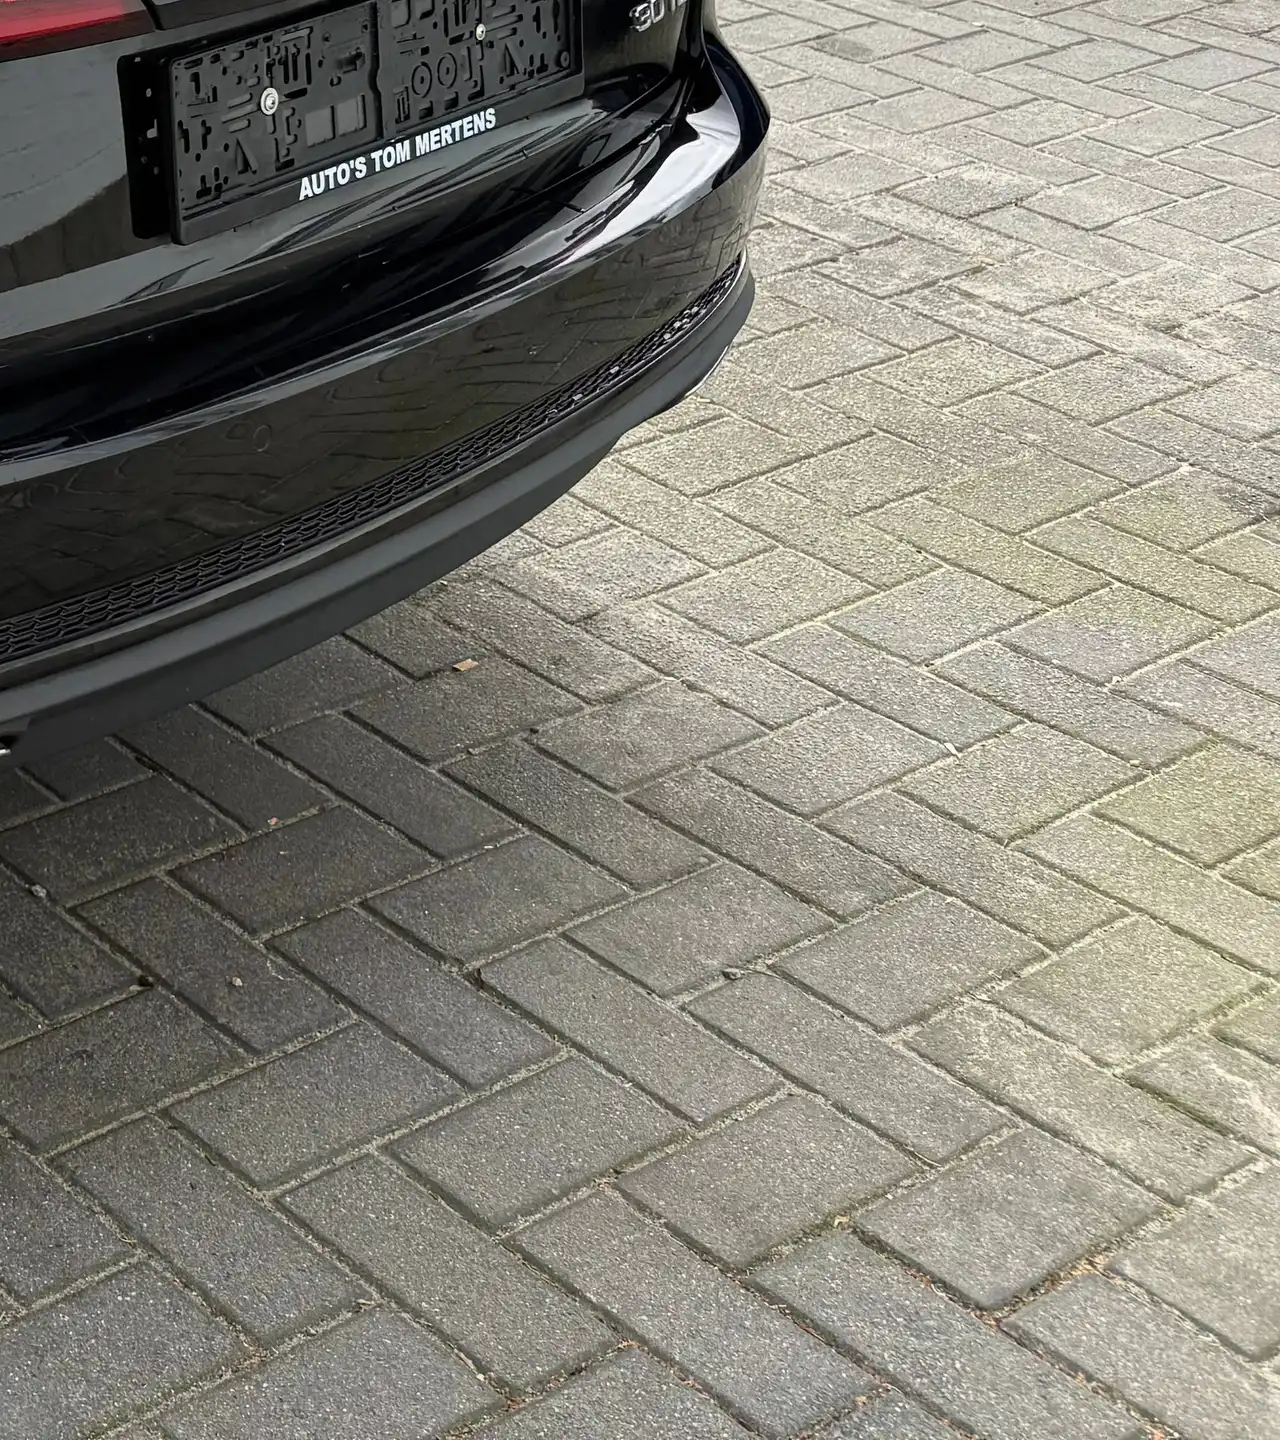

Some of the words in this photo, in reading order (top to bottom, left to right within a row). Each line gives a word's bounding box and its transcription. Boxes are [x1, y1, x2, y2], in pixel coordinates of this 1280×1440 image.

[299, 156, 367, 200] AUTO'S
[371, 139, 411, 172] TOM
[415, 107, 497, 157] MERTENS
